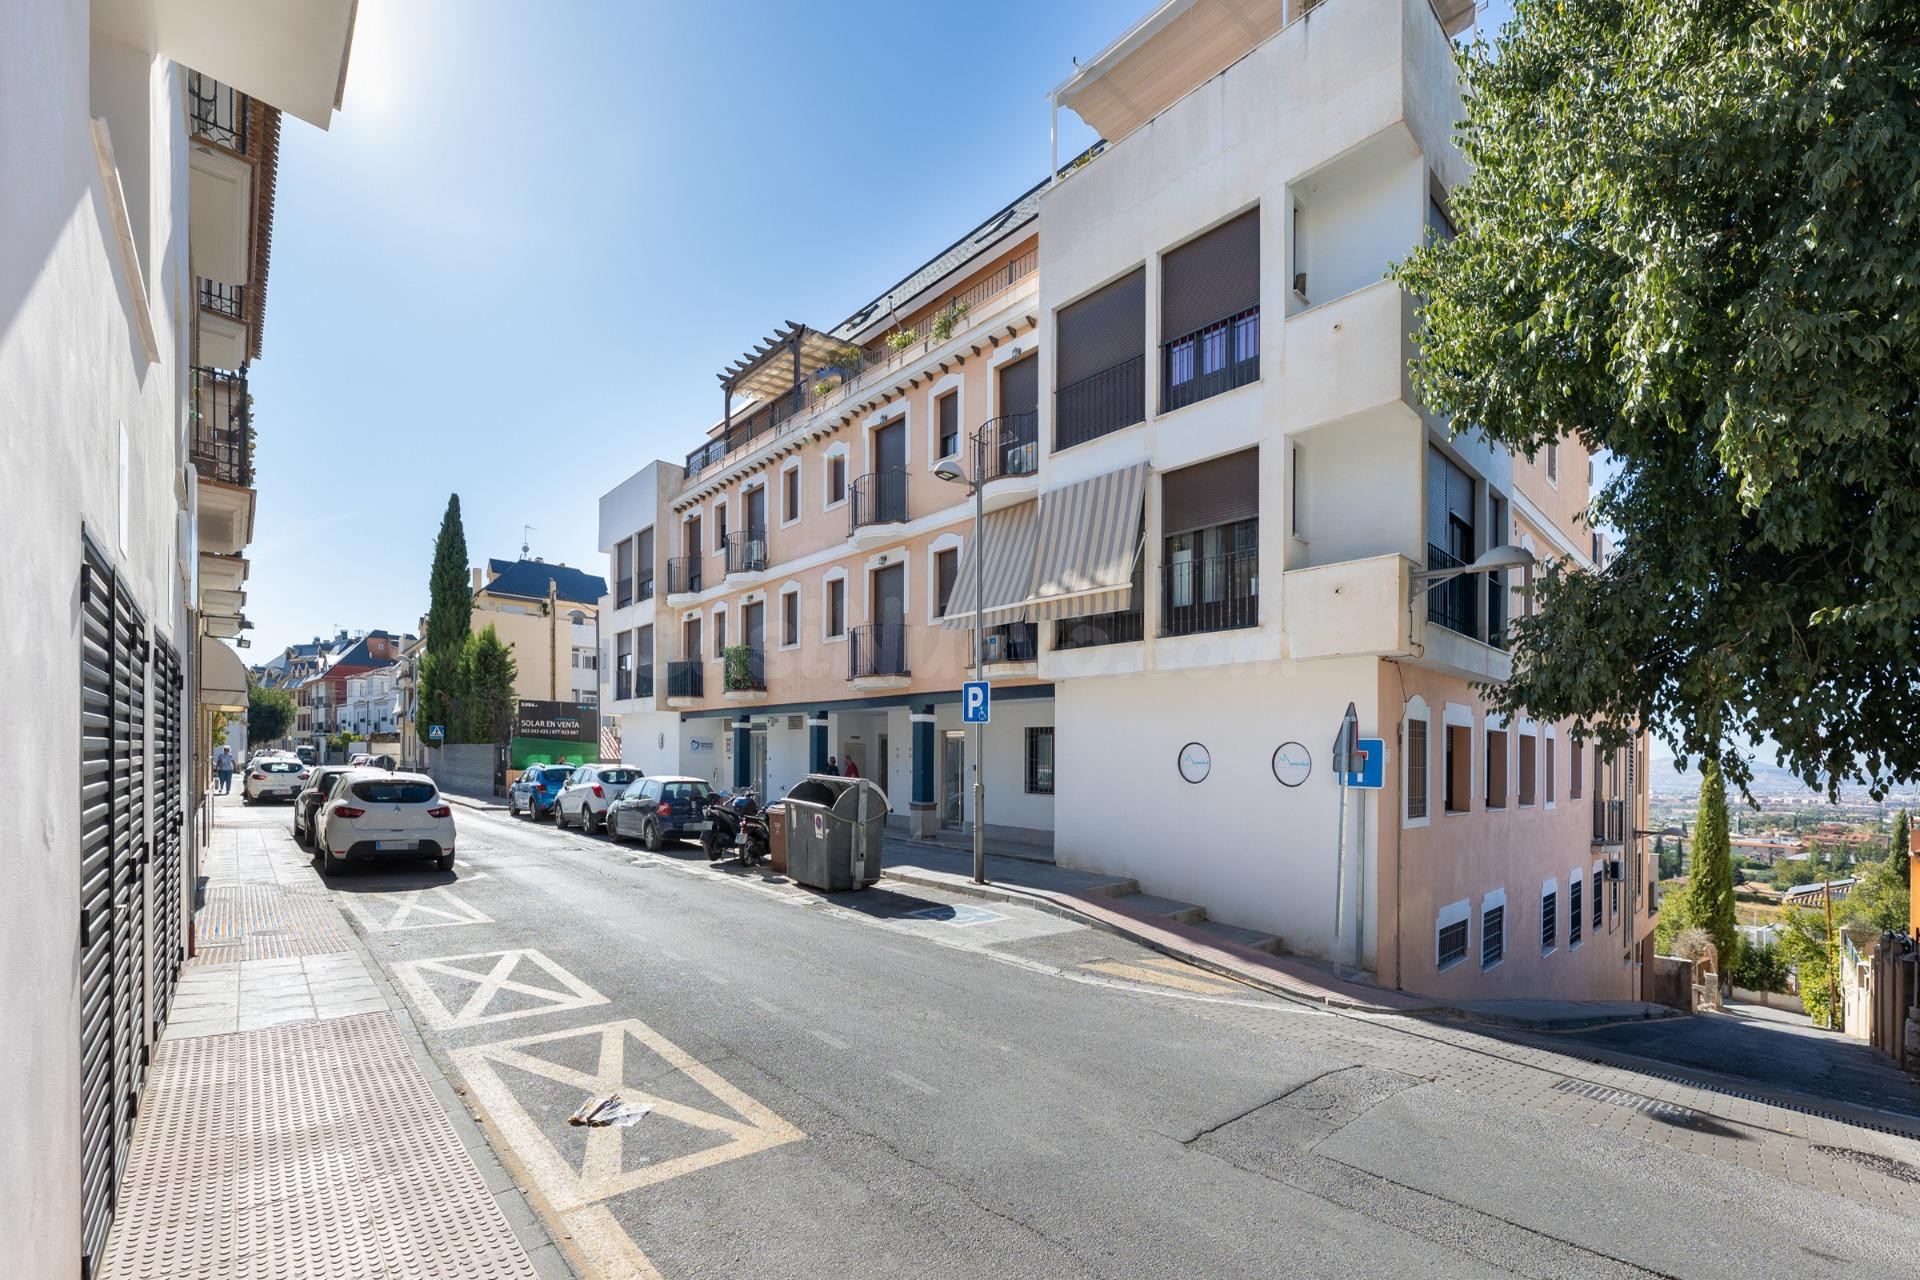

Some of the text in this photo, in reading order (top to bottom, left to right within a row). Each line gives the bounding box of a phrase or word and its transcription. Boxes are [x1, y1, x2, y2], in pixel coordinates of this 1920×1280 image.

[968, 687, 983, 718] P
[521, 720, 545, 728] SOLAR
[557, 721, 580, 729] VENTA
